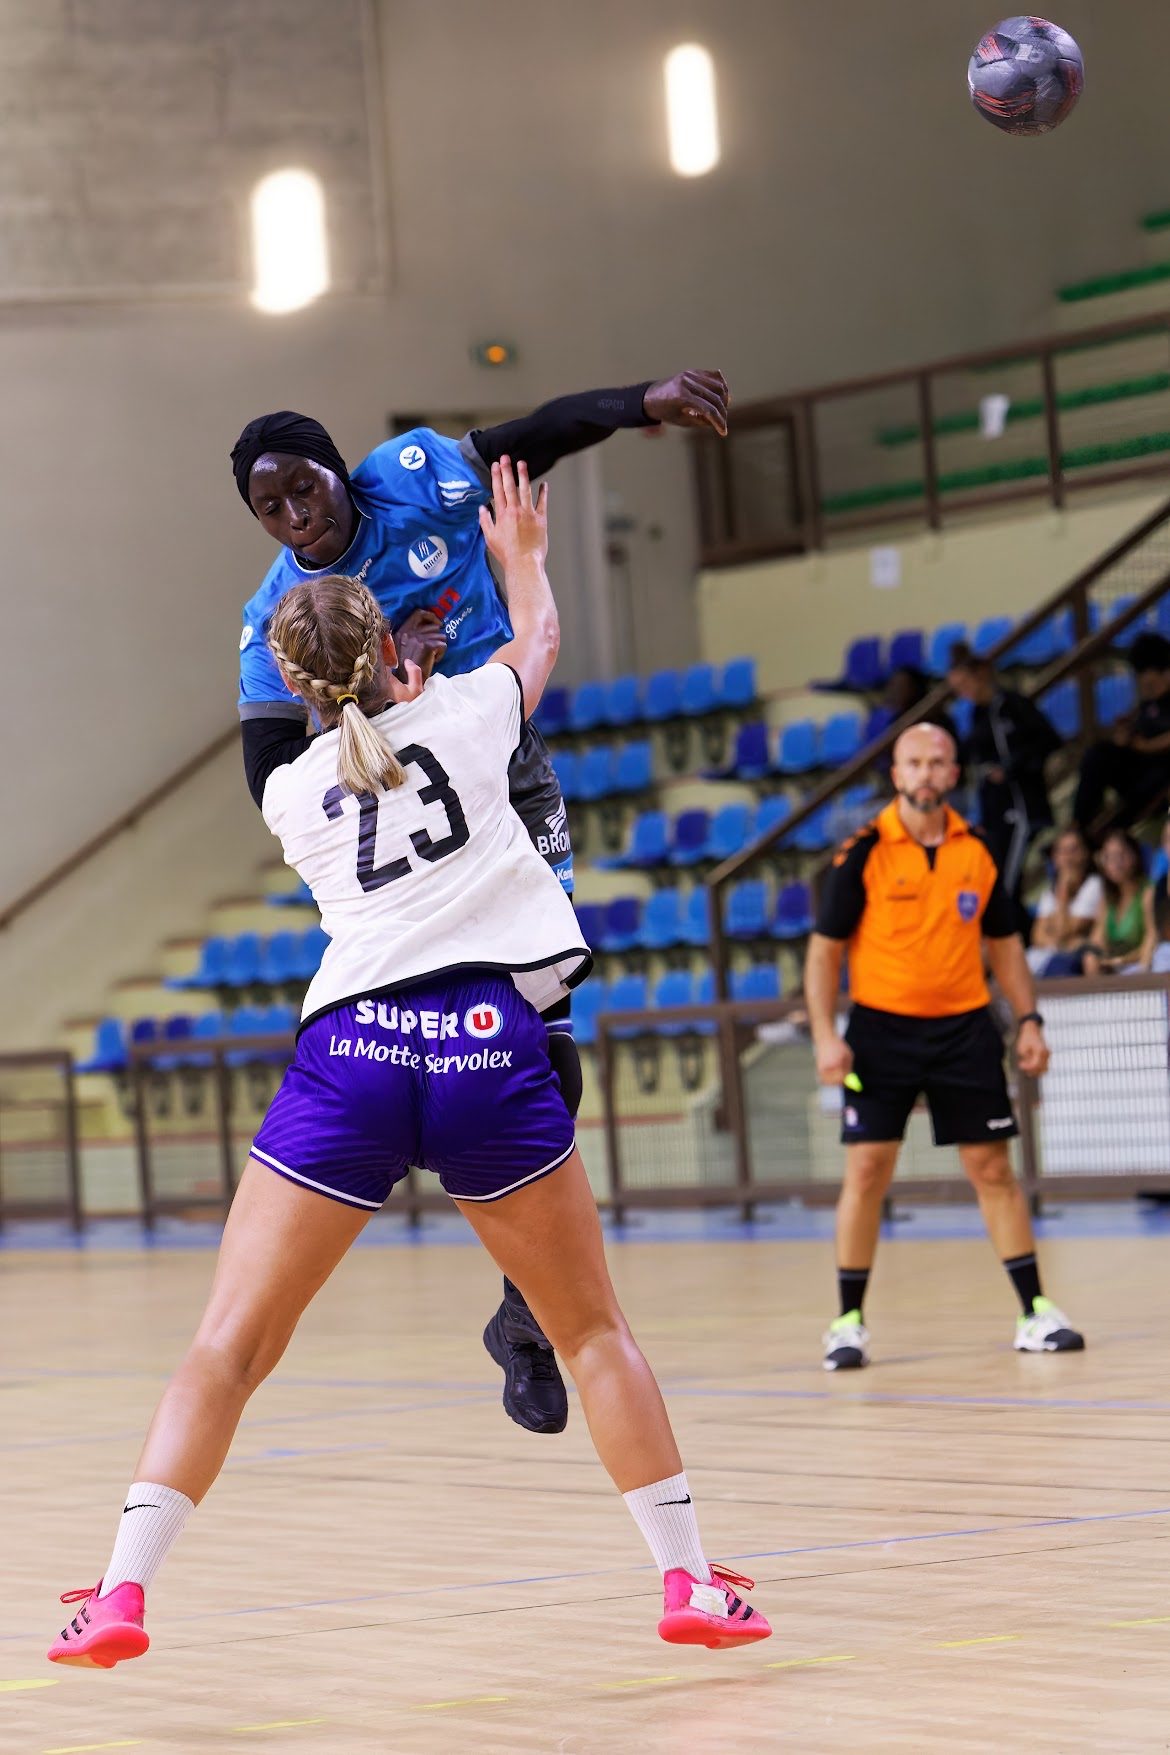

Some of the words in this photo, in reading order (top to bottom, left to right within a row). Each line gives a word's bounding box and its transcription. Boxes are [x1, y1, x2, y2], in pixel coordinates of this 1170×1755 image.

[423, 550, 443, 570] BRON
[322, 743, 470, 893] 23
[536, 830, 571, 855] BRON
[355, 999, 460, 1040] SUPER
[329, 1035, 351, 1056] La
[353, 1037, 421, 1070] Motte
[425, 1048, 513, 1074] Servolex
